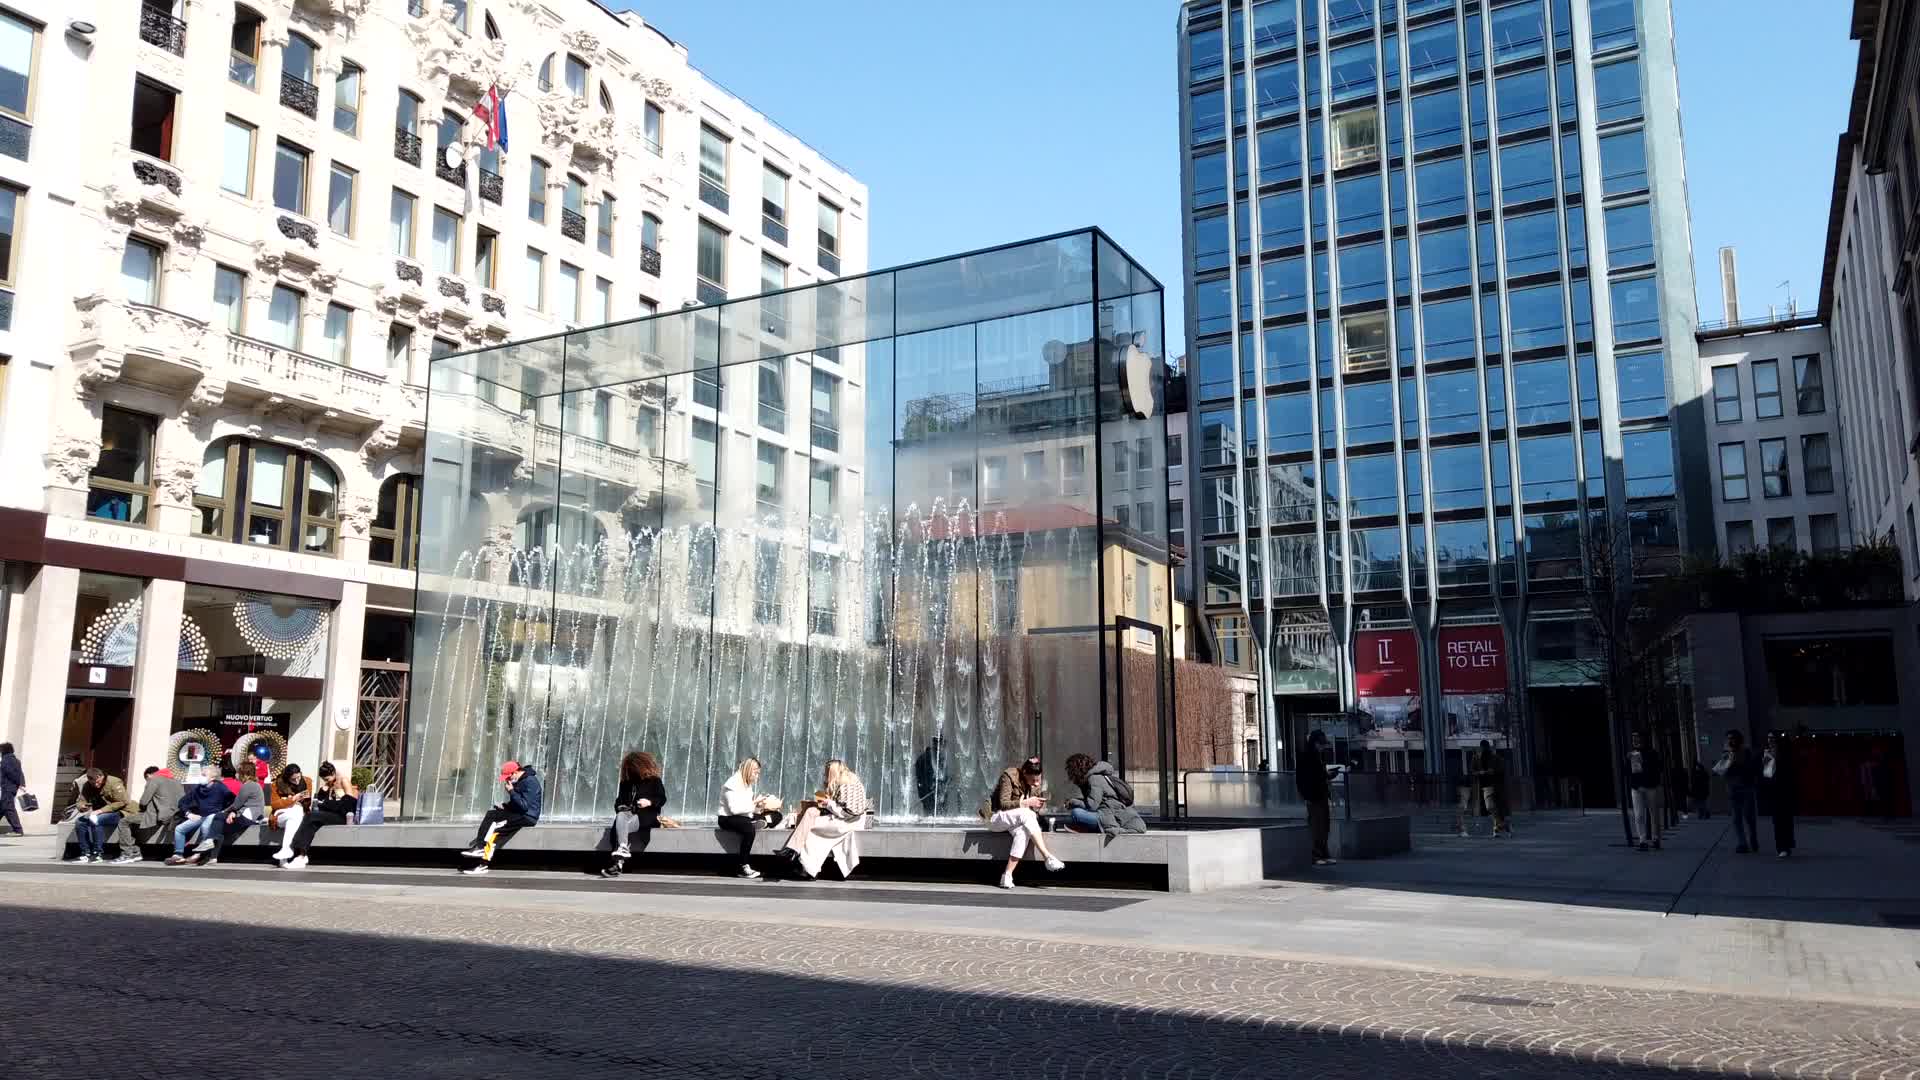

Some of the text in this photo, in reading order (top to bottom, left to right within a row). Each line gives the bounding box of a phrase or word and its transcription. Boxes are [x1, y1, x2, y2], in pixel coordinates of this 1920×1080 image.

[1447, 640, 1497, 653] RETAIL
[1448, 655, 1499, 668] TO LET
